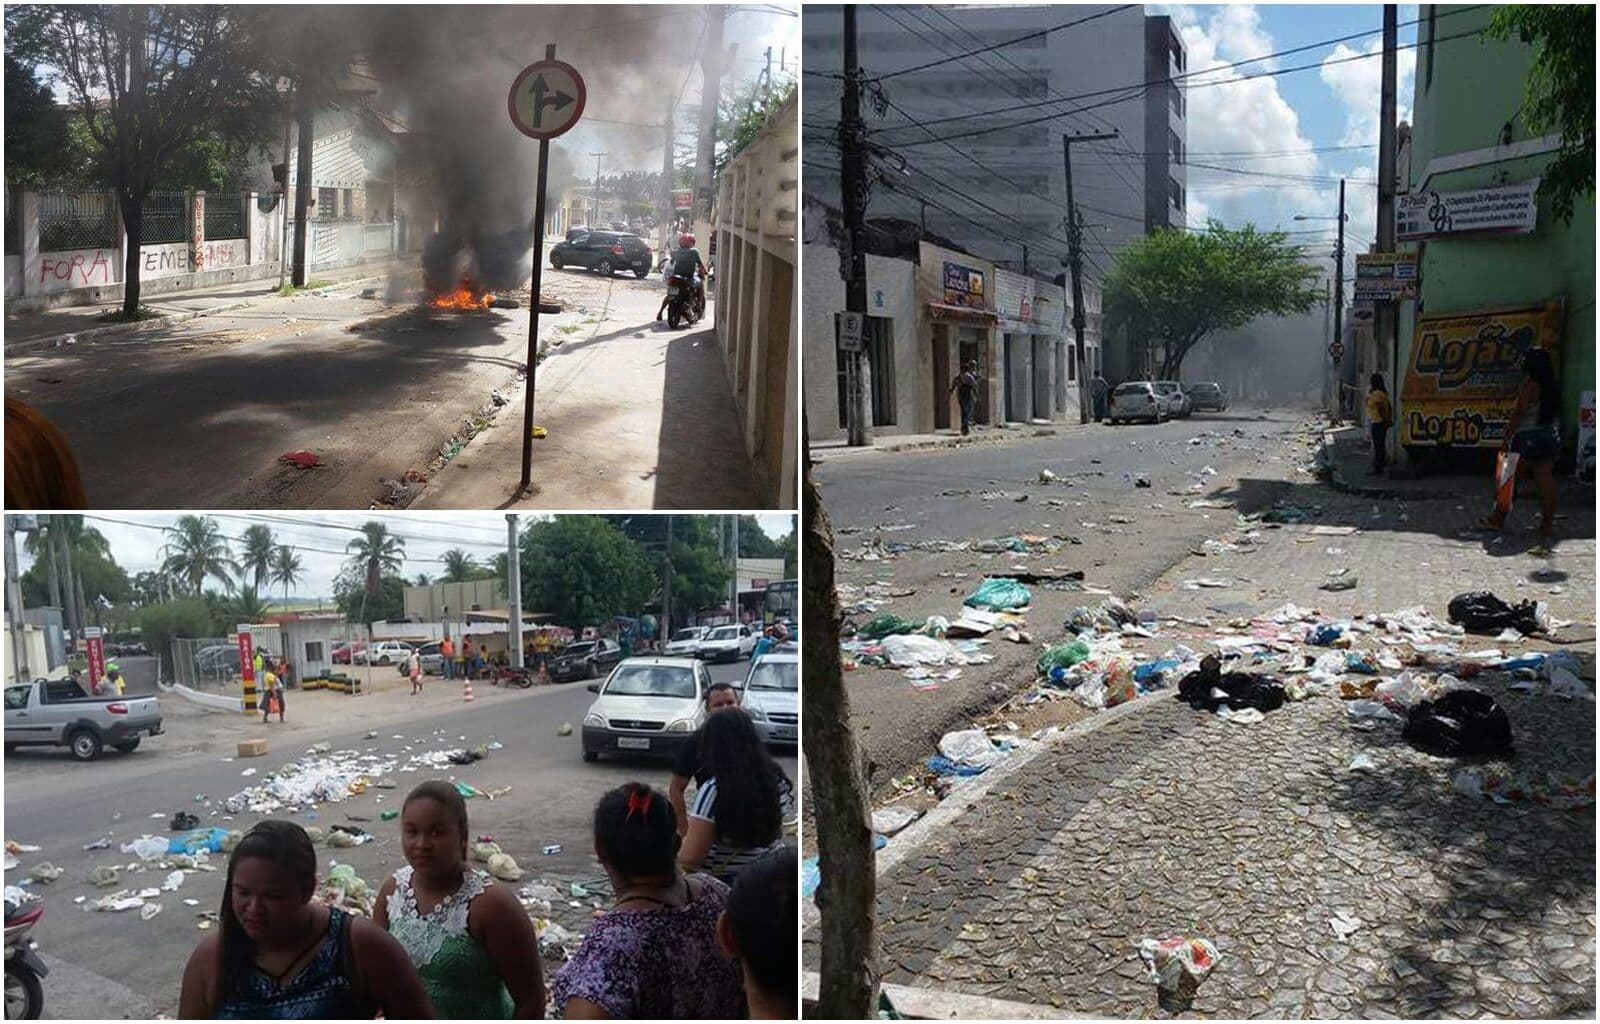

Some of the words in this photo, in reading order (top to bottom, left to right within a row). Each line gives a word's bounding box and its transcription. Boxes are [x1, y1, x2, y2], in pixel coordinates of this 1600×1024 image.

[40, 250, 108, 284] FORA
[1416, 324, 1518, 389] Lojão
[1410, 409, 1482, 446] Lojão
